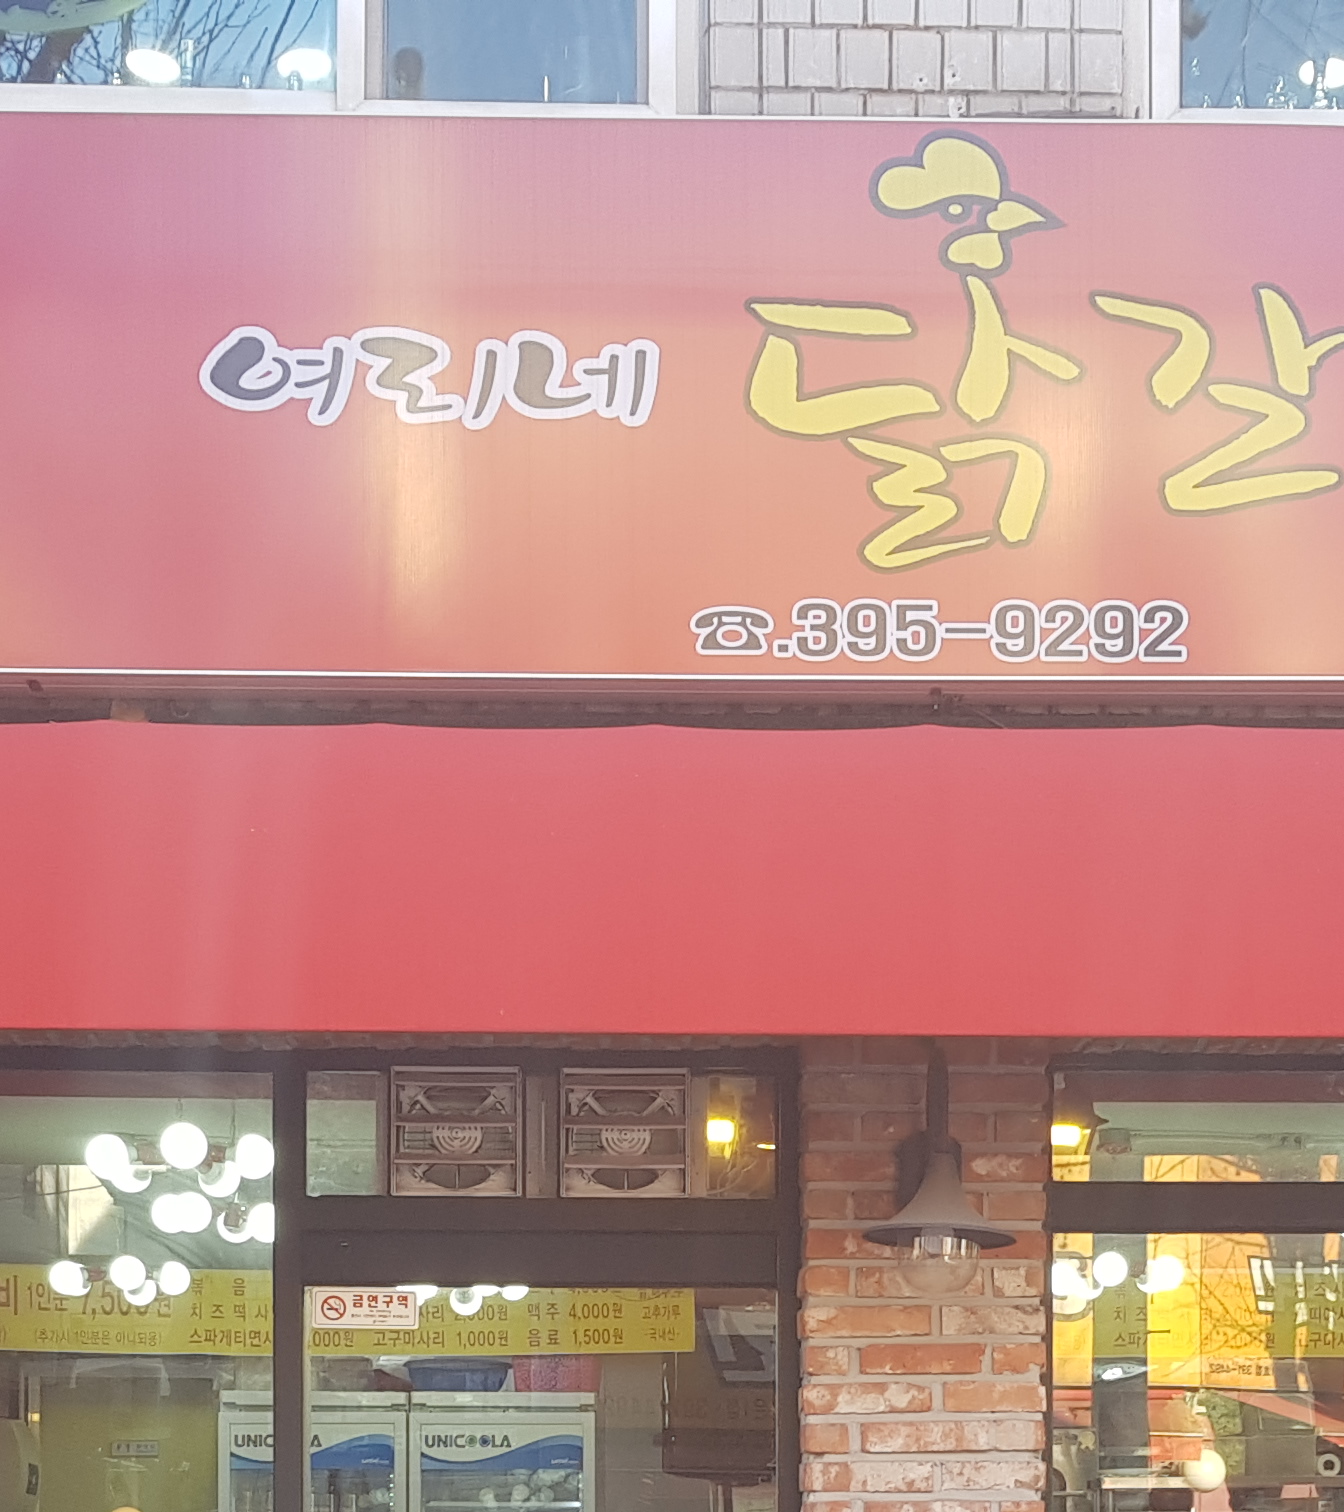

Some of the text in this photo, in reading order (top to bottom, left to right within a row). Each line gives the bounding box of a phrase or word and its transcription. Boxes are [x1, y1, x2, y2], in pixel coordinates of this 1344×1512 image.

[199, 326, 660, 431] 여리네
[352, 1294, 409, 1310] 금연구역
[568, 1303, 624, 1322] 4,000원
[373, 1330, 446, 1349] 고구마사리
[456, 1330, 509, 1350] 1,000원
[572, 1327, 624, 1347] 1,500원
